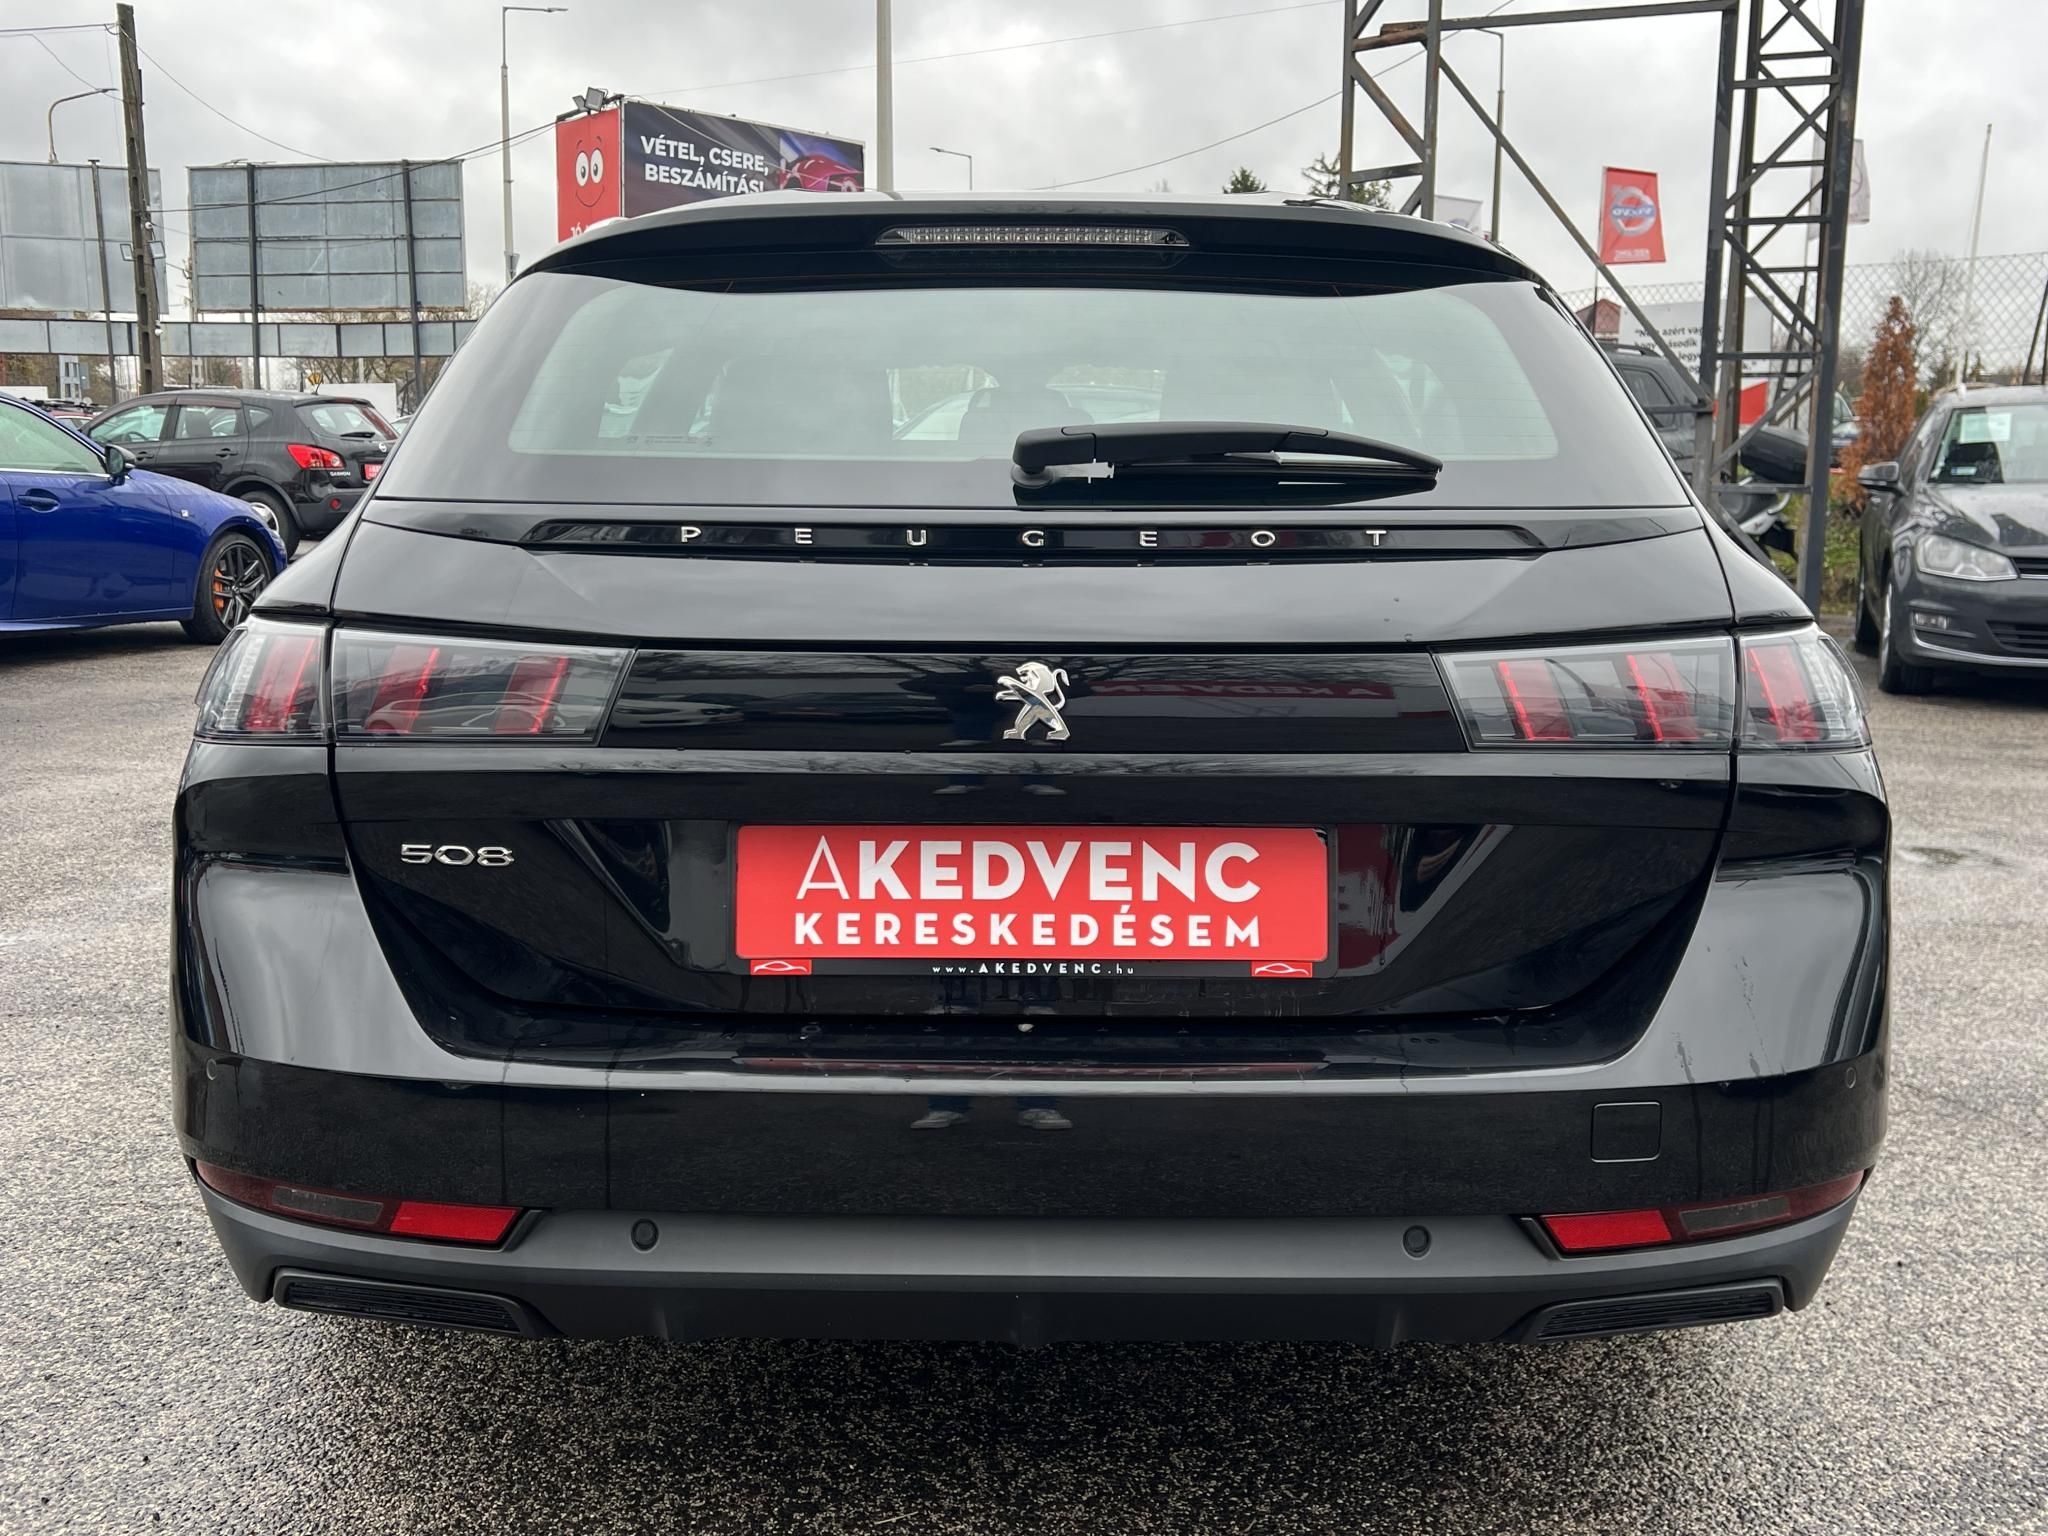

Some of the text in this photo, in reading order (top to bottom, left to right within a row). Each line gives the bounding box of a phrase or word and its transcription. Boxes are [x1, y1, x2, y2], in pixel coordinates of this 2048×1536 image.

[640, 134, 769, 176] VÉTEL, CSERE,
[644, 163, 765, 194] BESZÁMÍTÁS!
[1667, 338, 1697, 348] ásodik
[681, 526, 1387, 547] PEUGEOT
[400, 843, 515, 867] 508
[794, 905, 1261, 948] KERESKEDÉSEM
[932, 963, 1134, 974] www.AKEDVENC.hu
